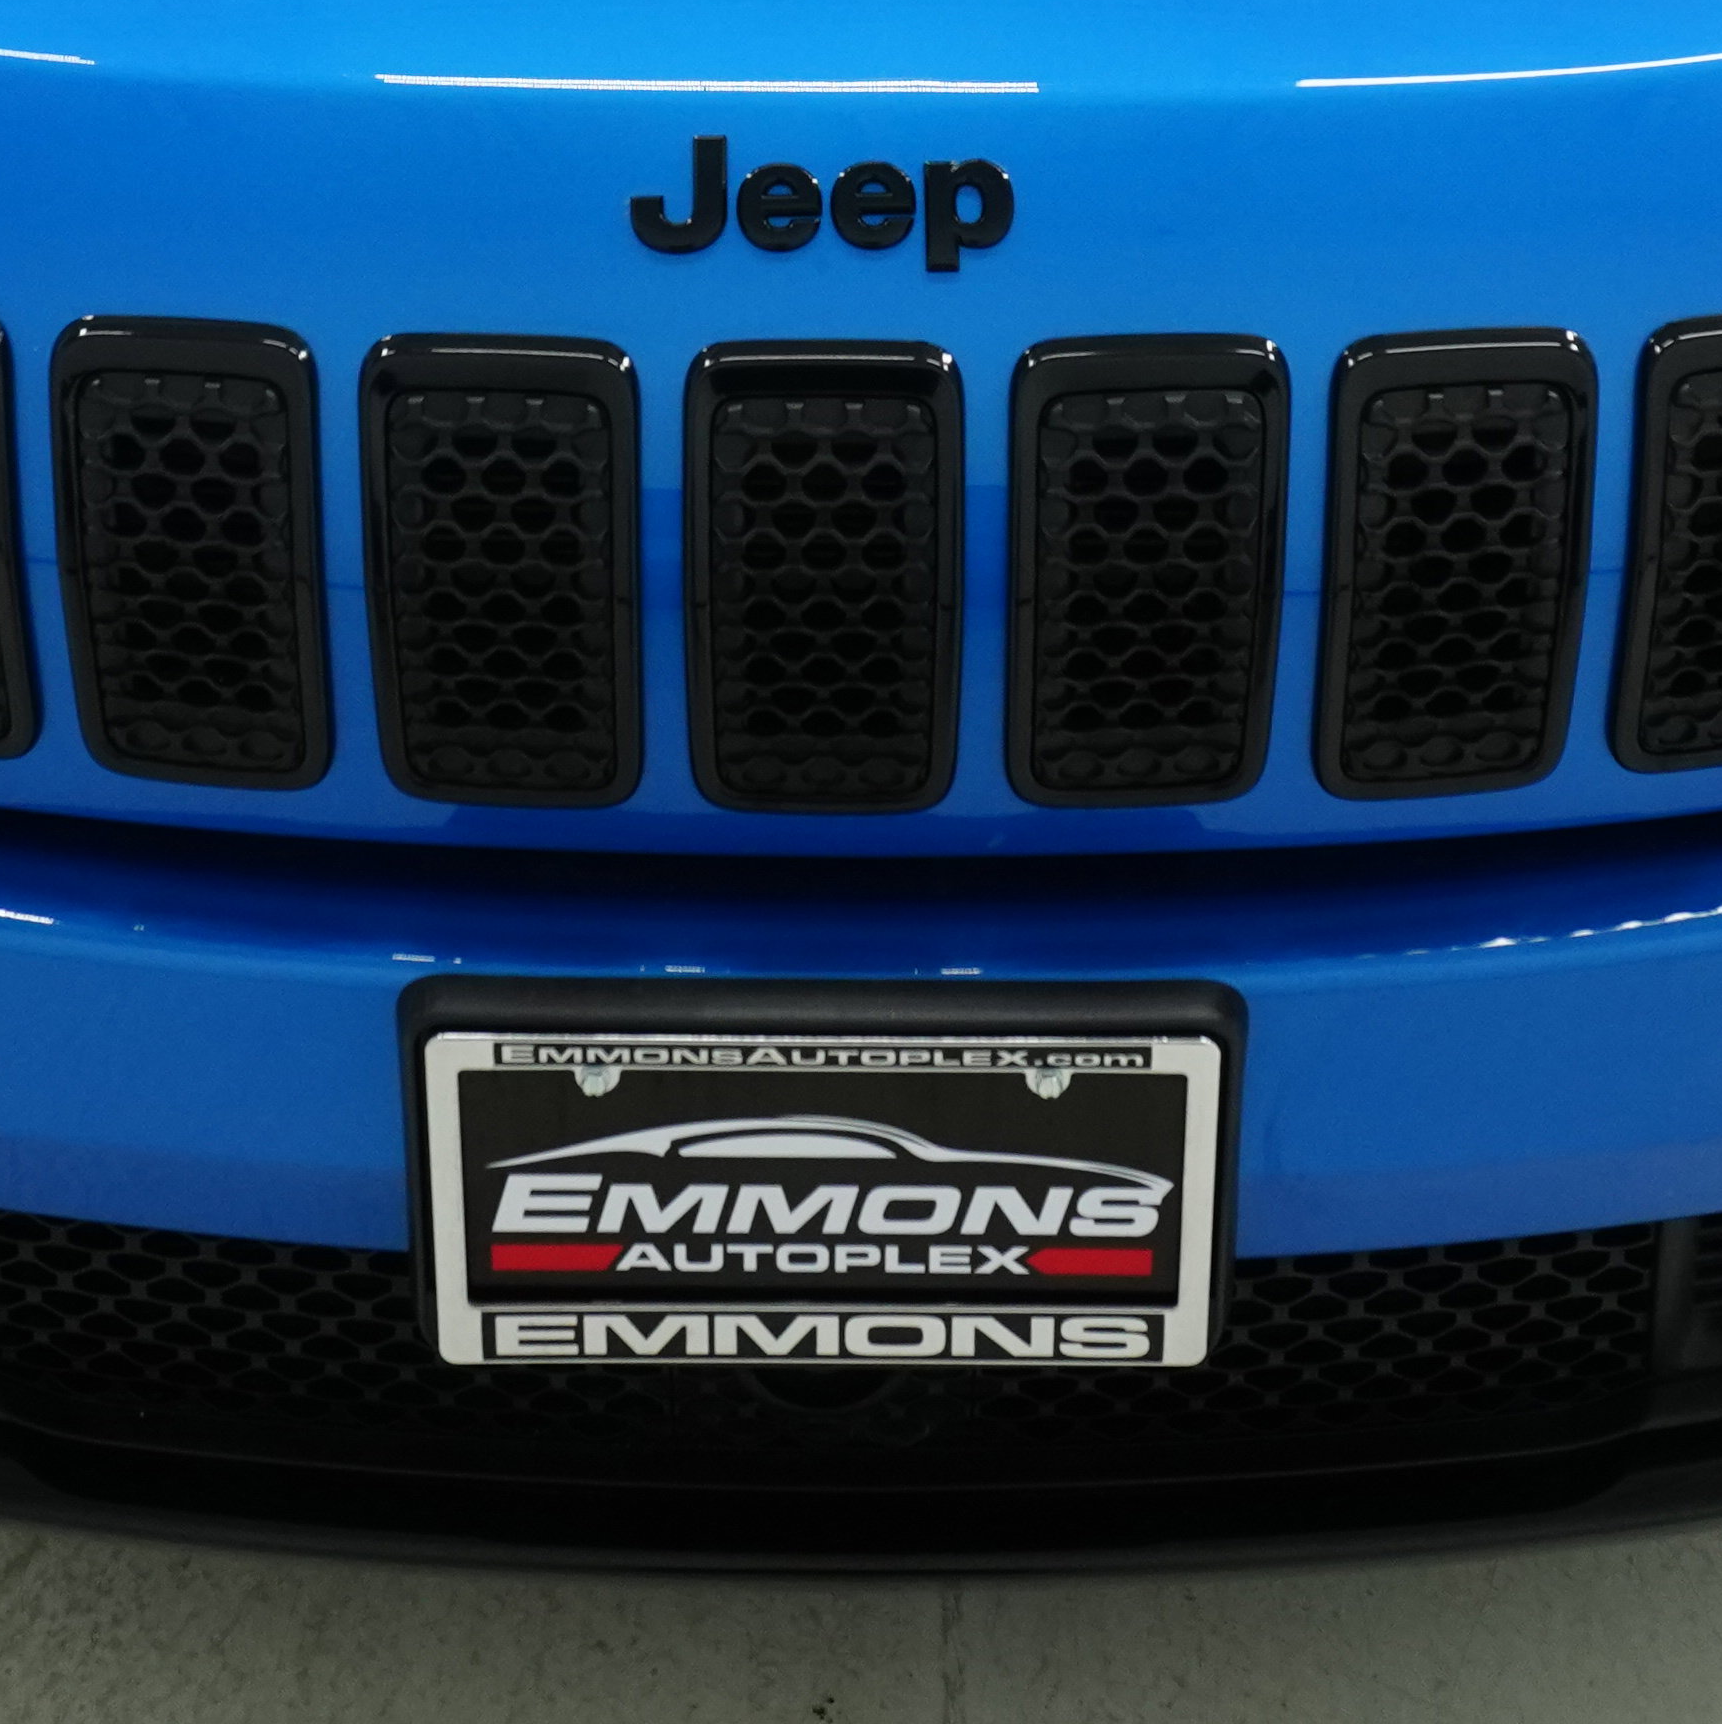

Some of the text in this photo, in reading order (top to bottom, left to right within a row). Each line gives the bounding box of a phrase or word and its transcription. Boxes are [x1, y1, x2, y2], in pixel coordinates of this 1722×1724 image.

[630, 135, 1015, 272] Jeep
[491, 1173, 1163, 1237] EMMONS
[615, 1242, 1031, 1275] AUTOPLEX
[494, 1315, 1150, 1358] EMMONS
